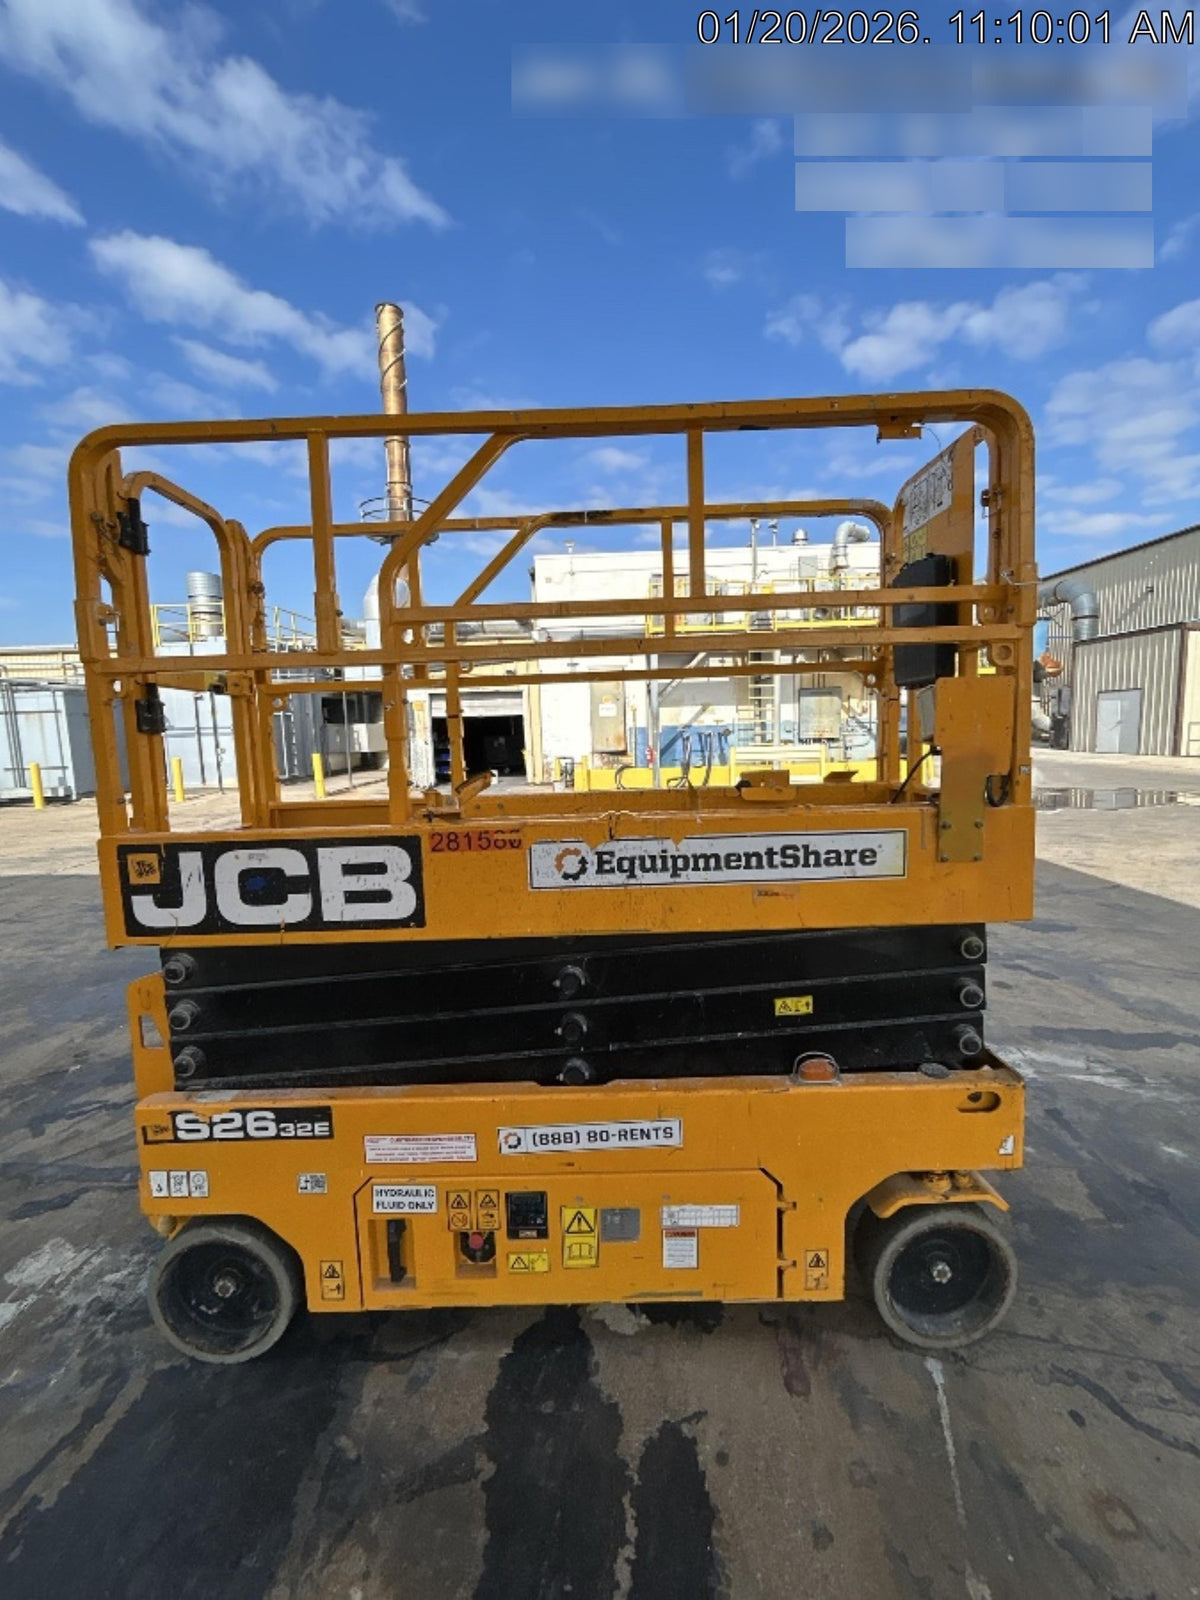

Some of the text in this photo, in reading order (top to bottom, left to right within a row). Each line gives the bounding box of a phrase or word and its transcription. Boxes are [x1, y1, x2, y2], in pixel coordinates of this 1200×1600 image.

[595, 843, 877, 878] EquipmentShare
[131, 845, 417, 927] JCB
[175, 1110, 278, 1140] S26
[279, 1121, 330, 1137] 32E
[532, 1126, 674, 1147] (888) 80-RENTS
[375, 1188, 435, 1198] HYDRAULIC
[376, 1200, 435, 1210] FLUID ONLY
